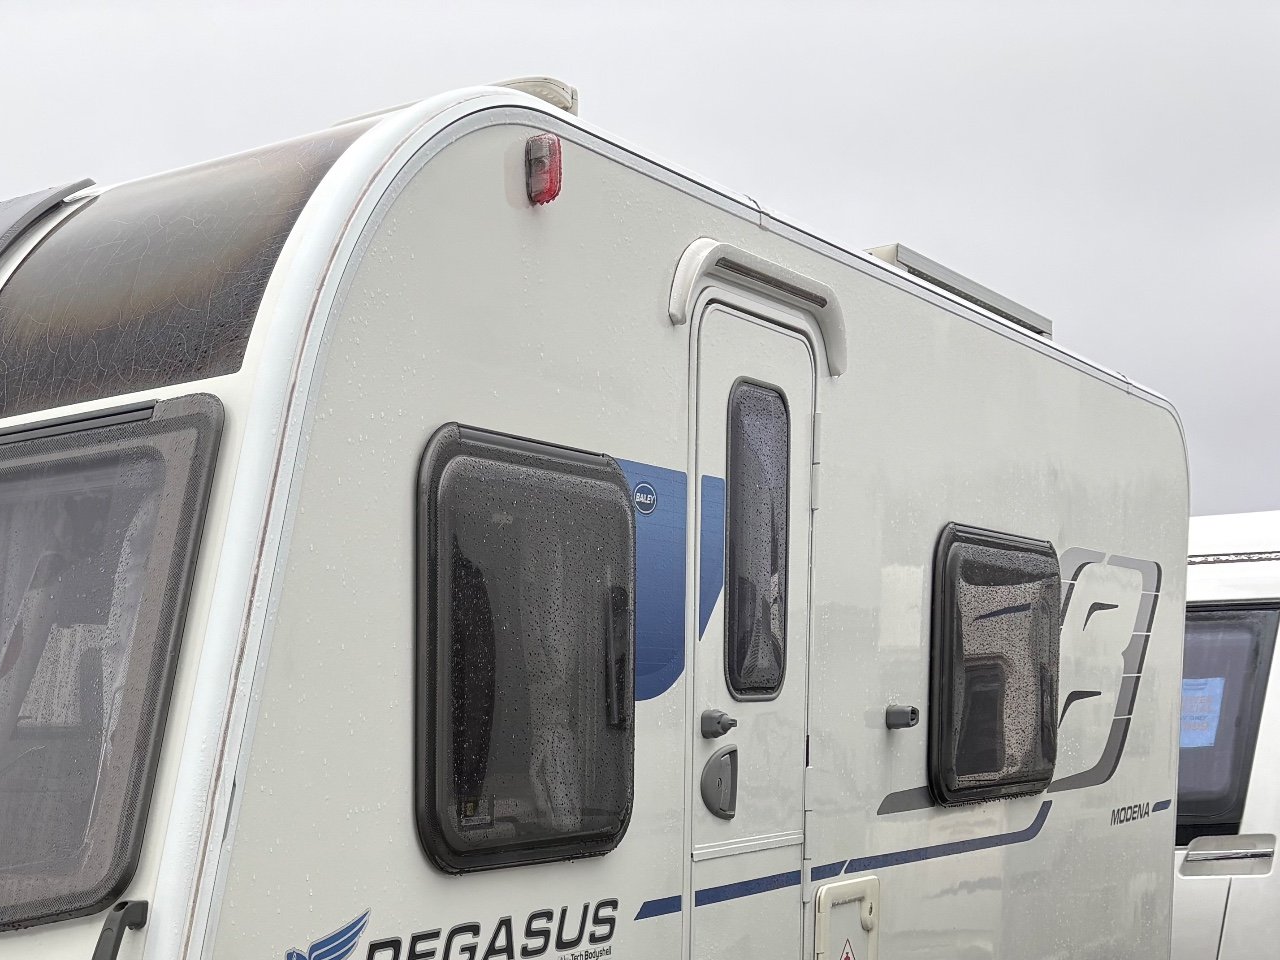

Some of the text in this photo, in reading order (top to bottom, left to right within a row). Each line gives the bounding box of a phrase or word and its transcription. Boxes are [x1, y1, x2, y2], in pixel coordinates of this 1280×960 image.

[635, 492, 655, 504] BAILEY
[1110, 801, 1150, 826] MODENA
[584, 945, 612, 960] Bodyshell
